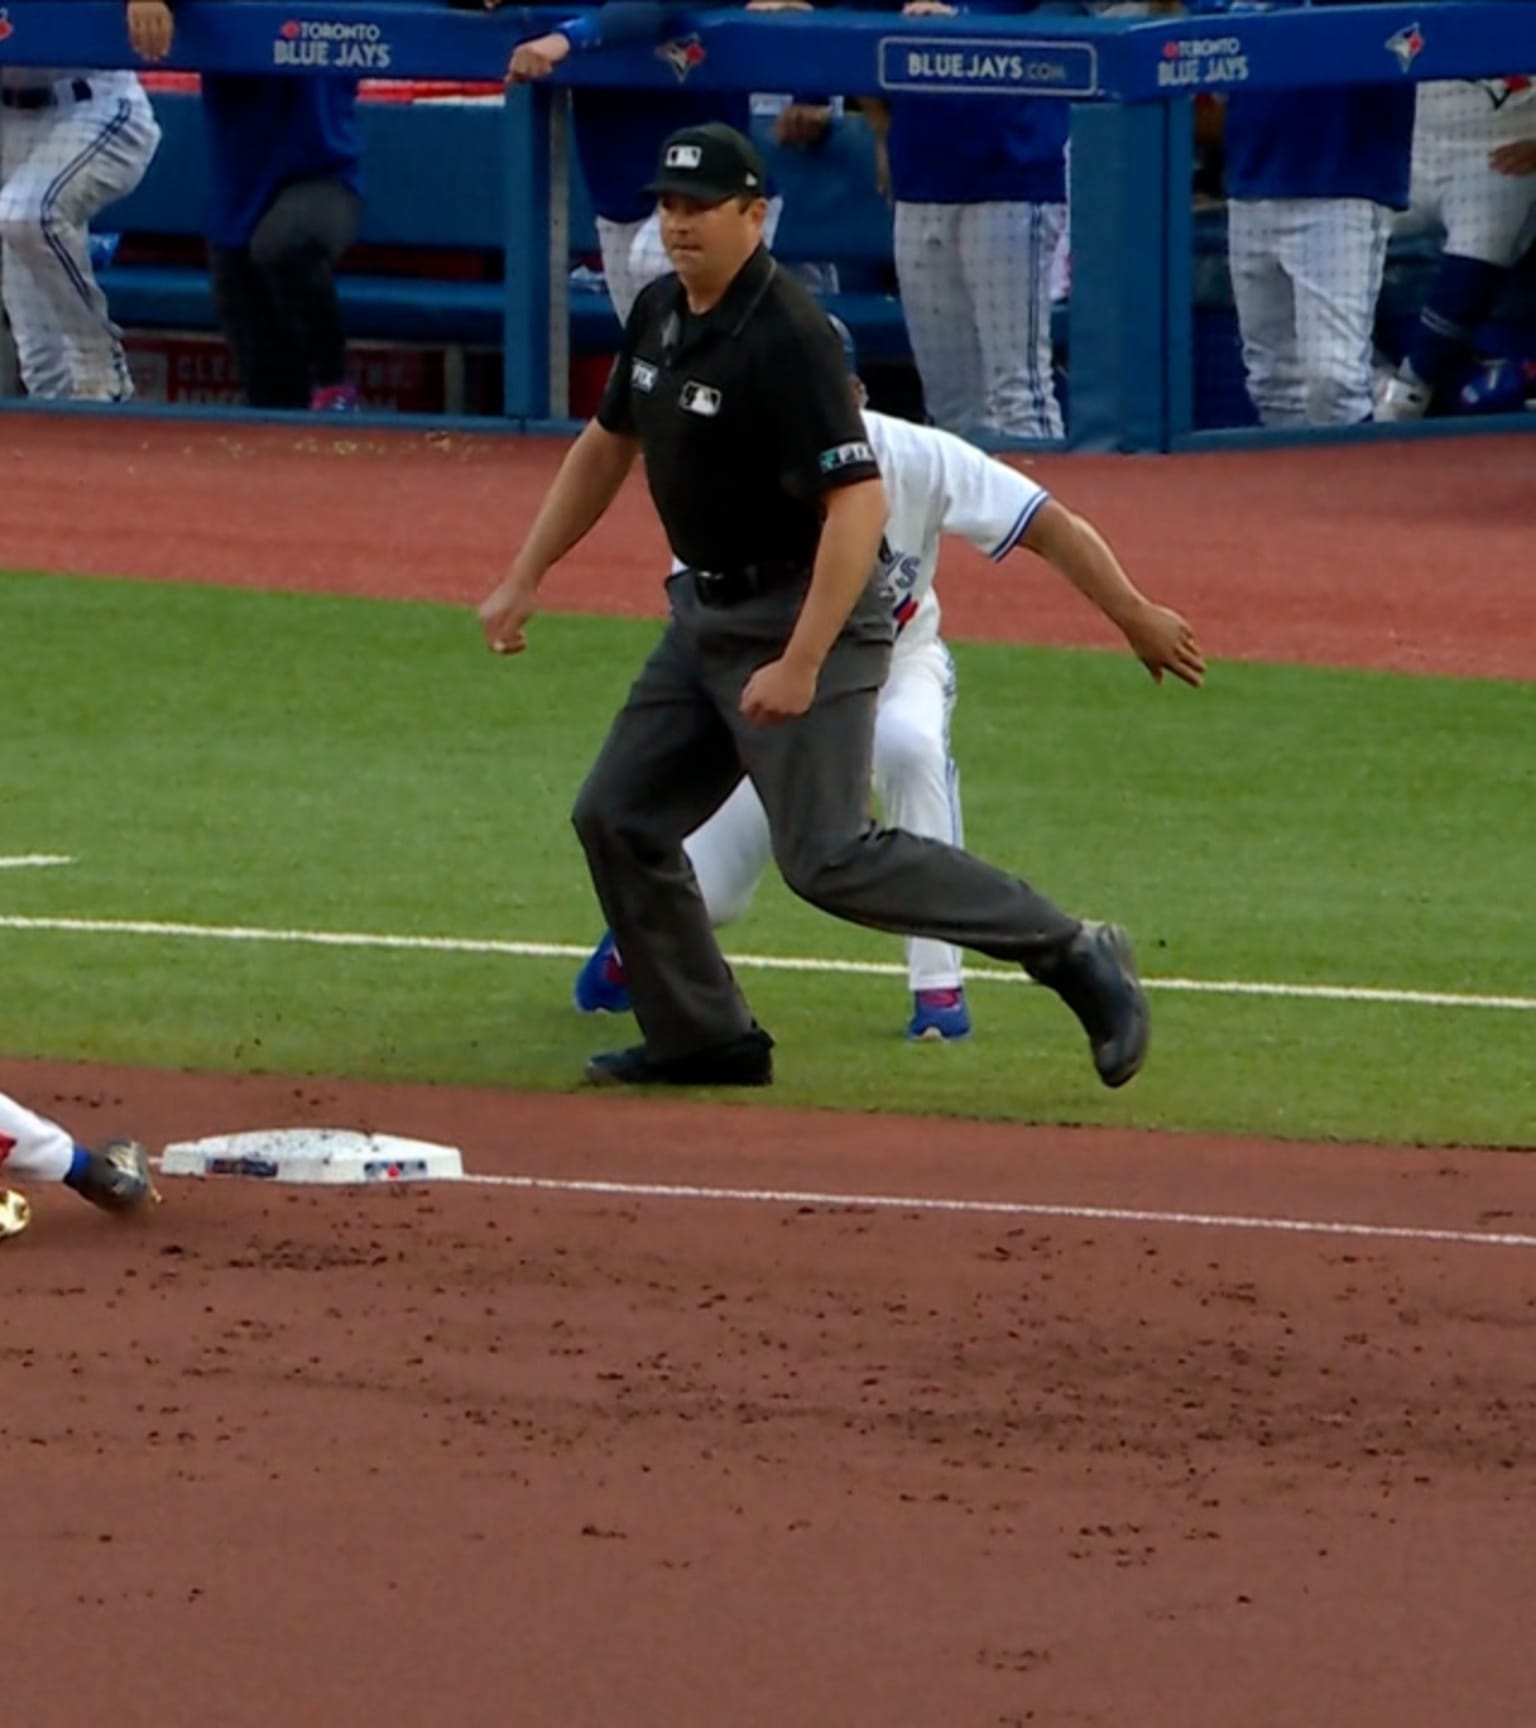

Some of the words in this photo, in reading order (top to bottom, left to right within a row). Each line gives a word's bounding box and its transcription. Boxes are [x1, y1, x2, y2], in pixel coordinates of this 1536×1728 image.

[300, 21, 380, 41] TORONTO
[273, 40, 329, 65] BLUE
[333, 43, 391, 67] JAYS
[1178, 37, 1240, 58] TORONTO
[1157, 59, 1200, 87] BLUE
[1204, 55, 1249, 83] JAYS
